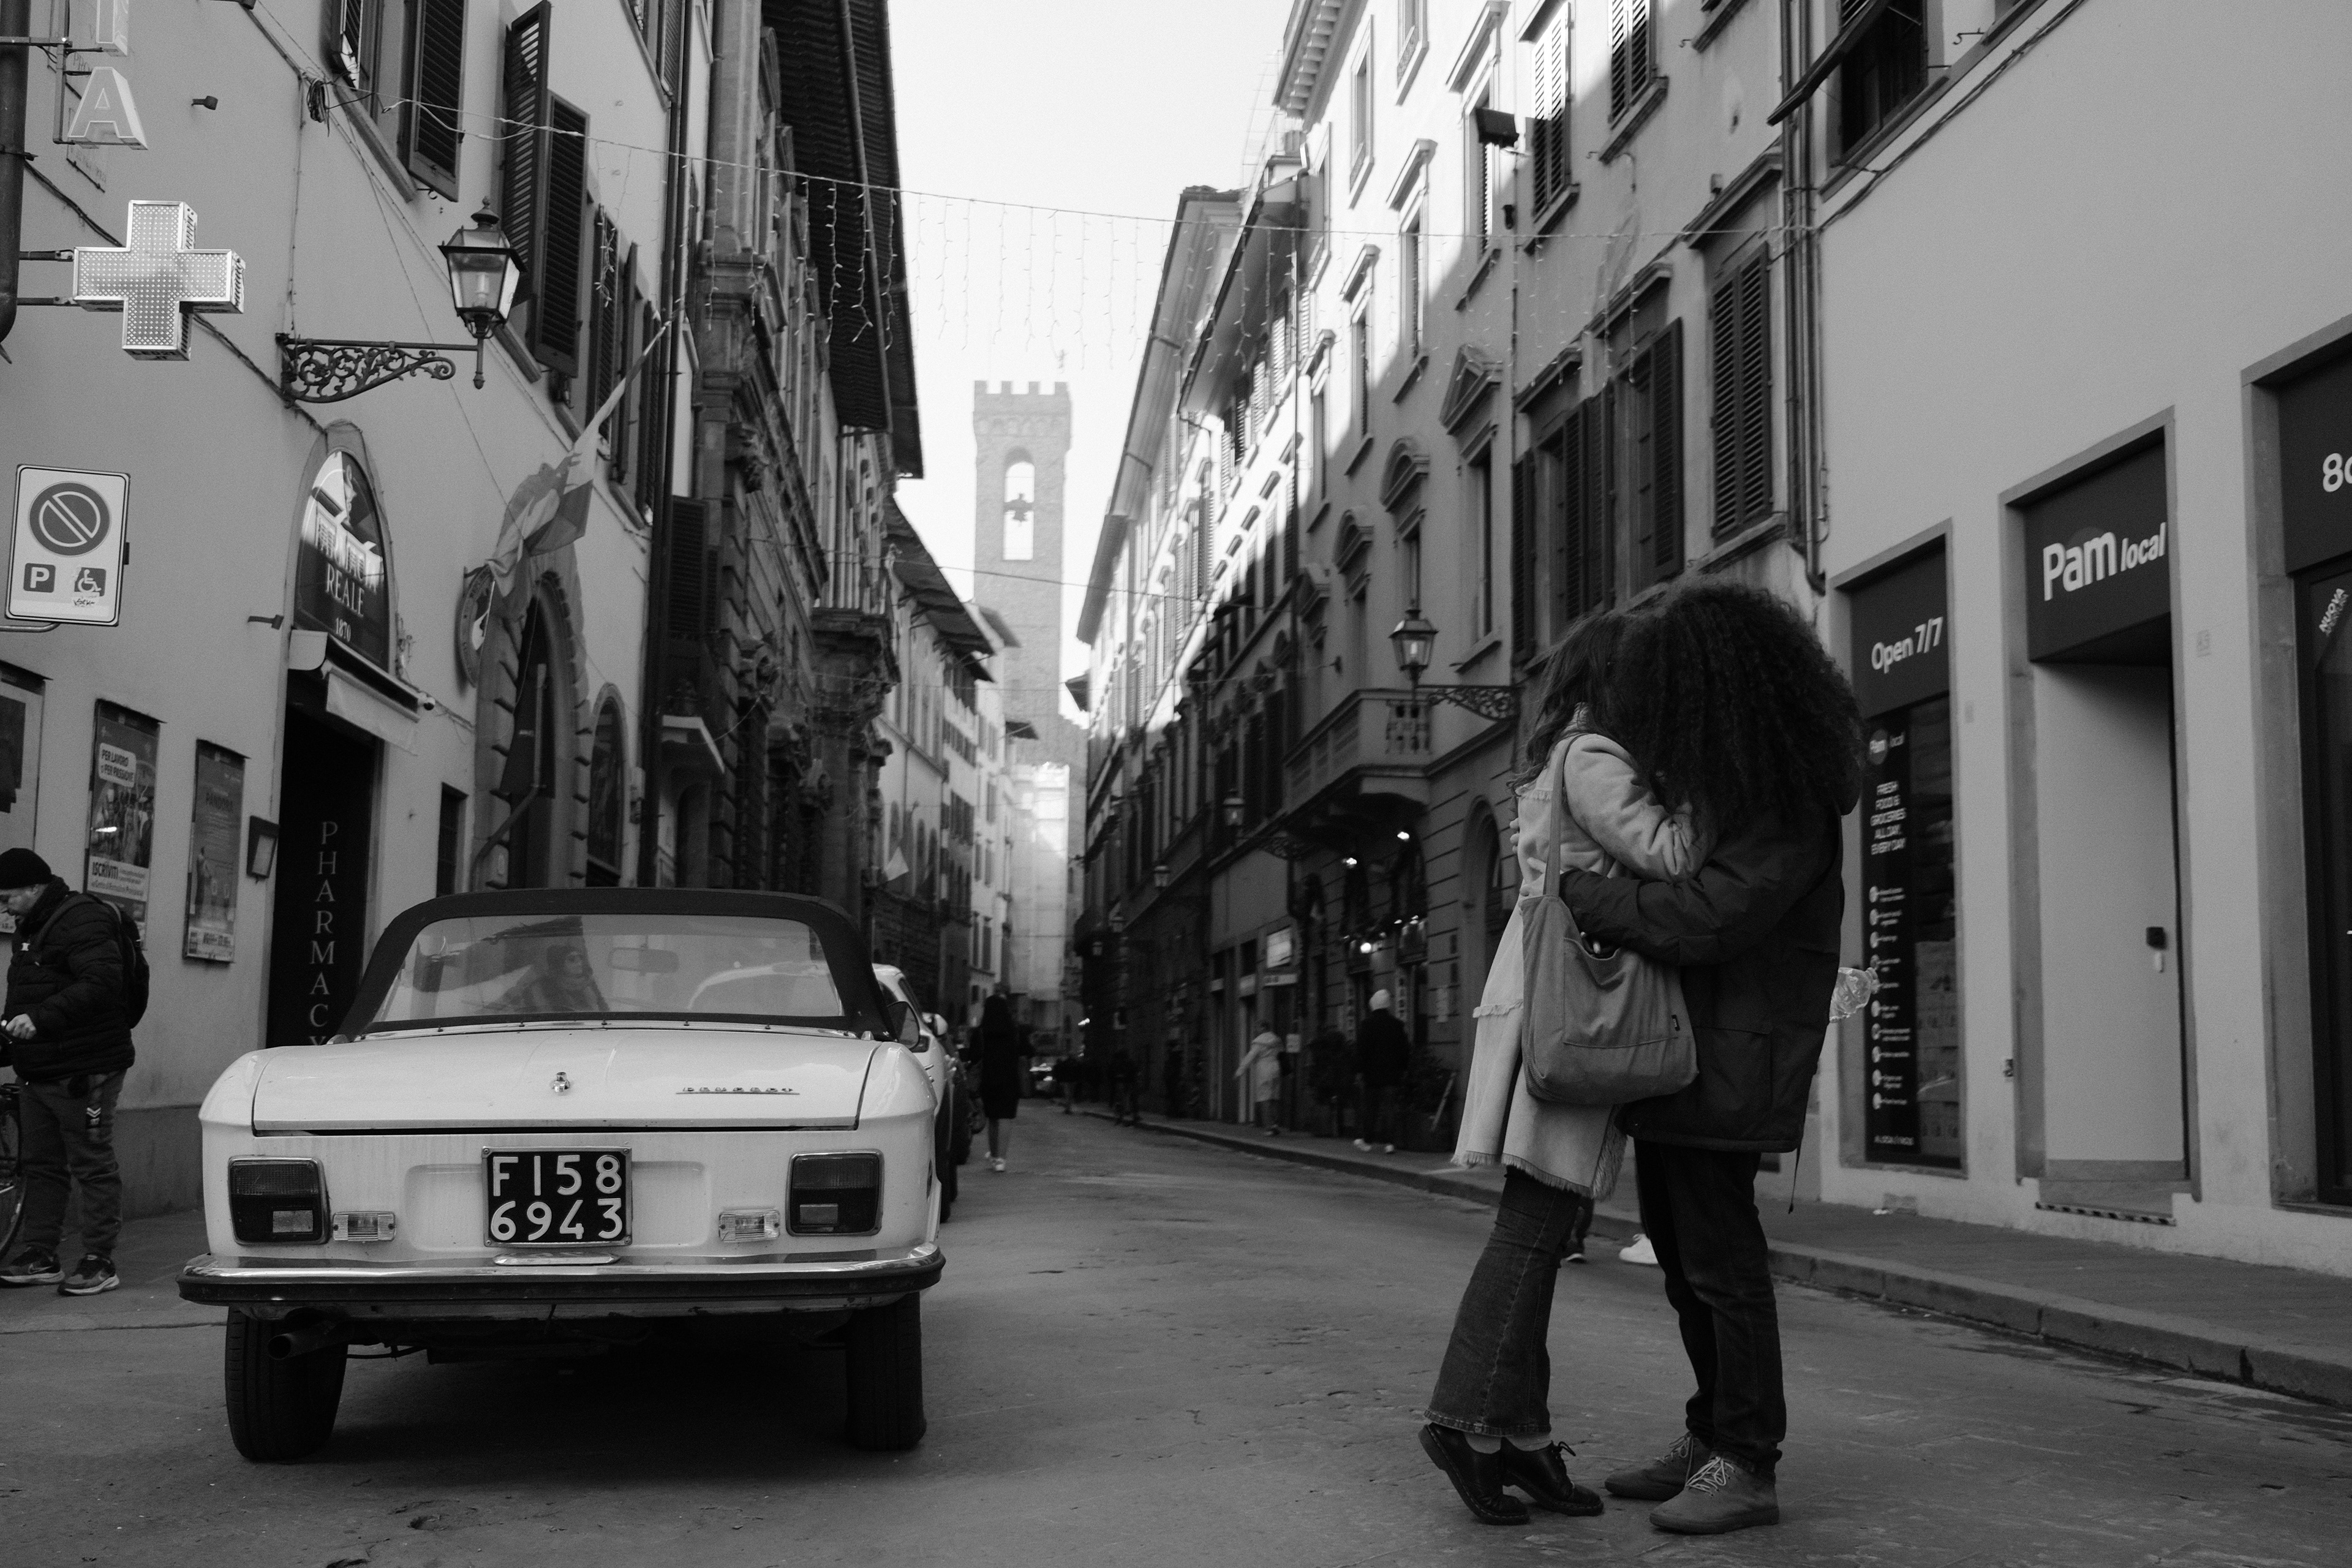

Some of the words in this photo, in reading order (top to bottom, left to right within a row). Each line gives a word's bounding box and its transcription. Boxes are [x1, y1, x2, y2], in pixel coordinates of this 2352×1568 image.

[30, 567, 50, 589] P
[2043, 532, 2117, 601] Pam
[2120, 522, 2166, 572] local
[325, 562, 365, 617] REALE
[336, 617, 352, 643] 1870
[1871, 641, 1914, 674] Open
[1915, 616, 1943, 654] 7/7
[491, 1197, 623, 1241] 6943
